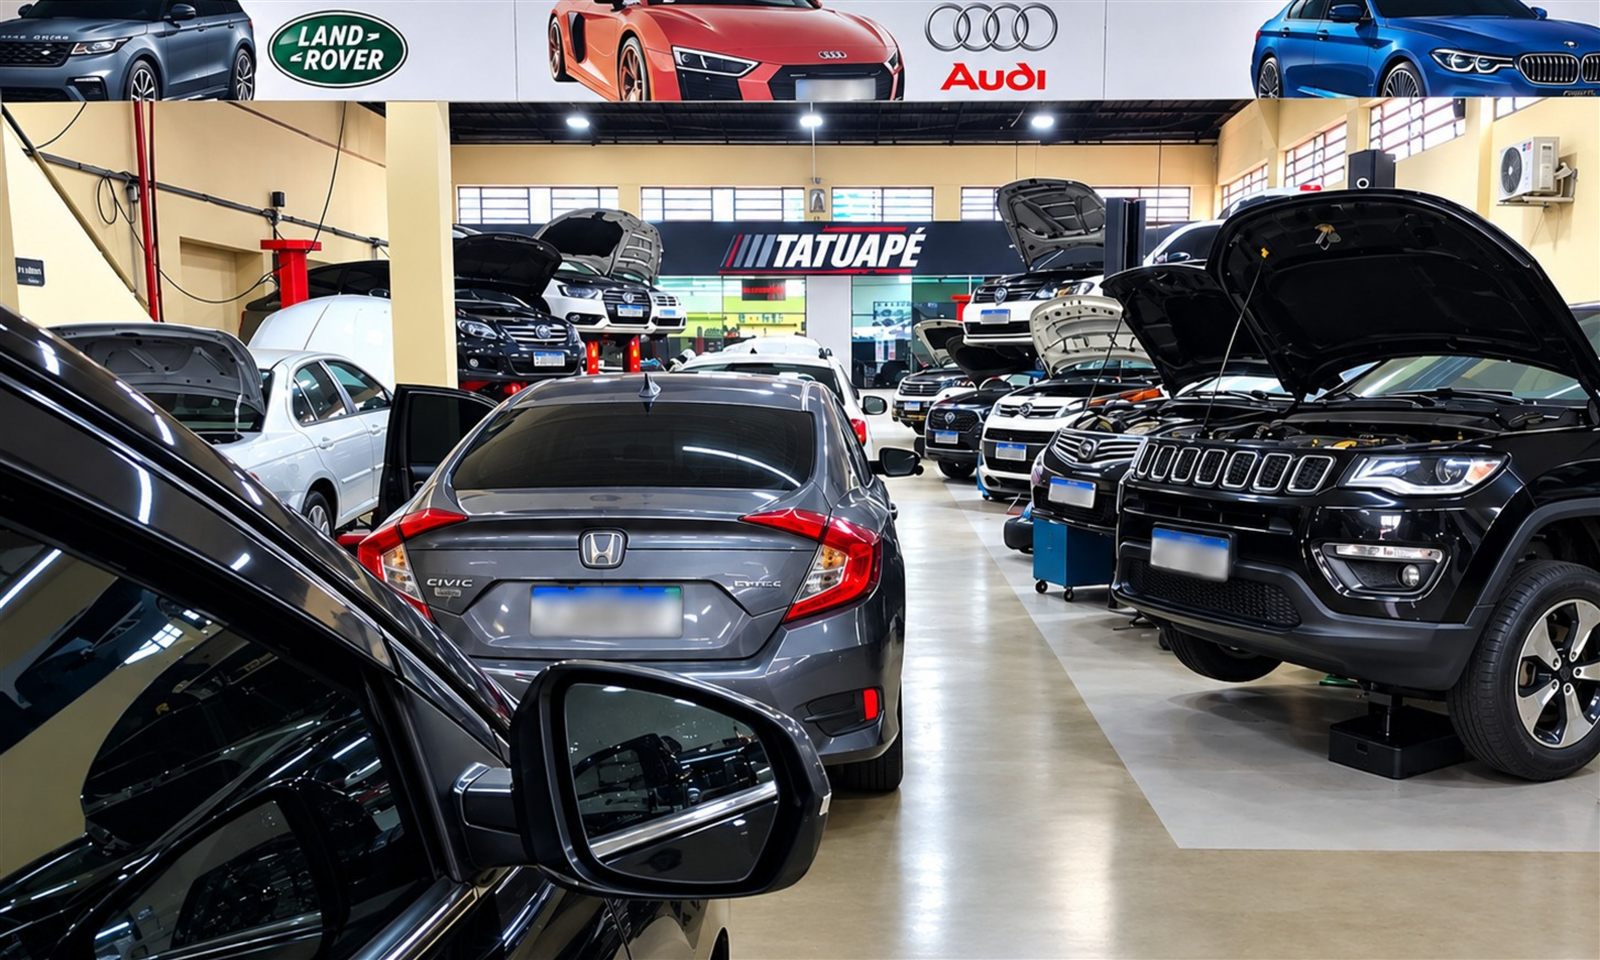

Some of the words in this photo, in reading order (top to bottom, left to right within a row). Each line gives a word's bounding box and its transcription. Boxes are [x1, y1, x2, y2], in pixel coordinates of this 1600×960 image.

[297, 25, 364, 47] LAND
[303, 49, 384, 70] ROVER
[940, 62, 1046, 91] Audi
[773, 227, 926, 268] TATUAPÉ
[426, 578, 473, 587] CIVIC
